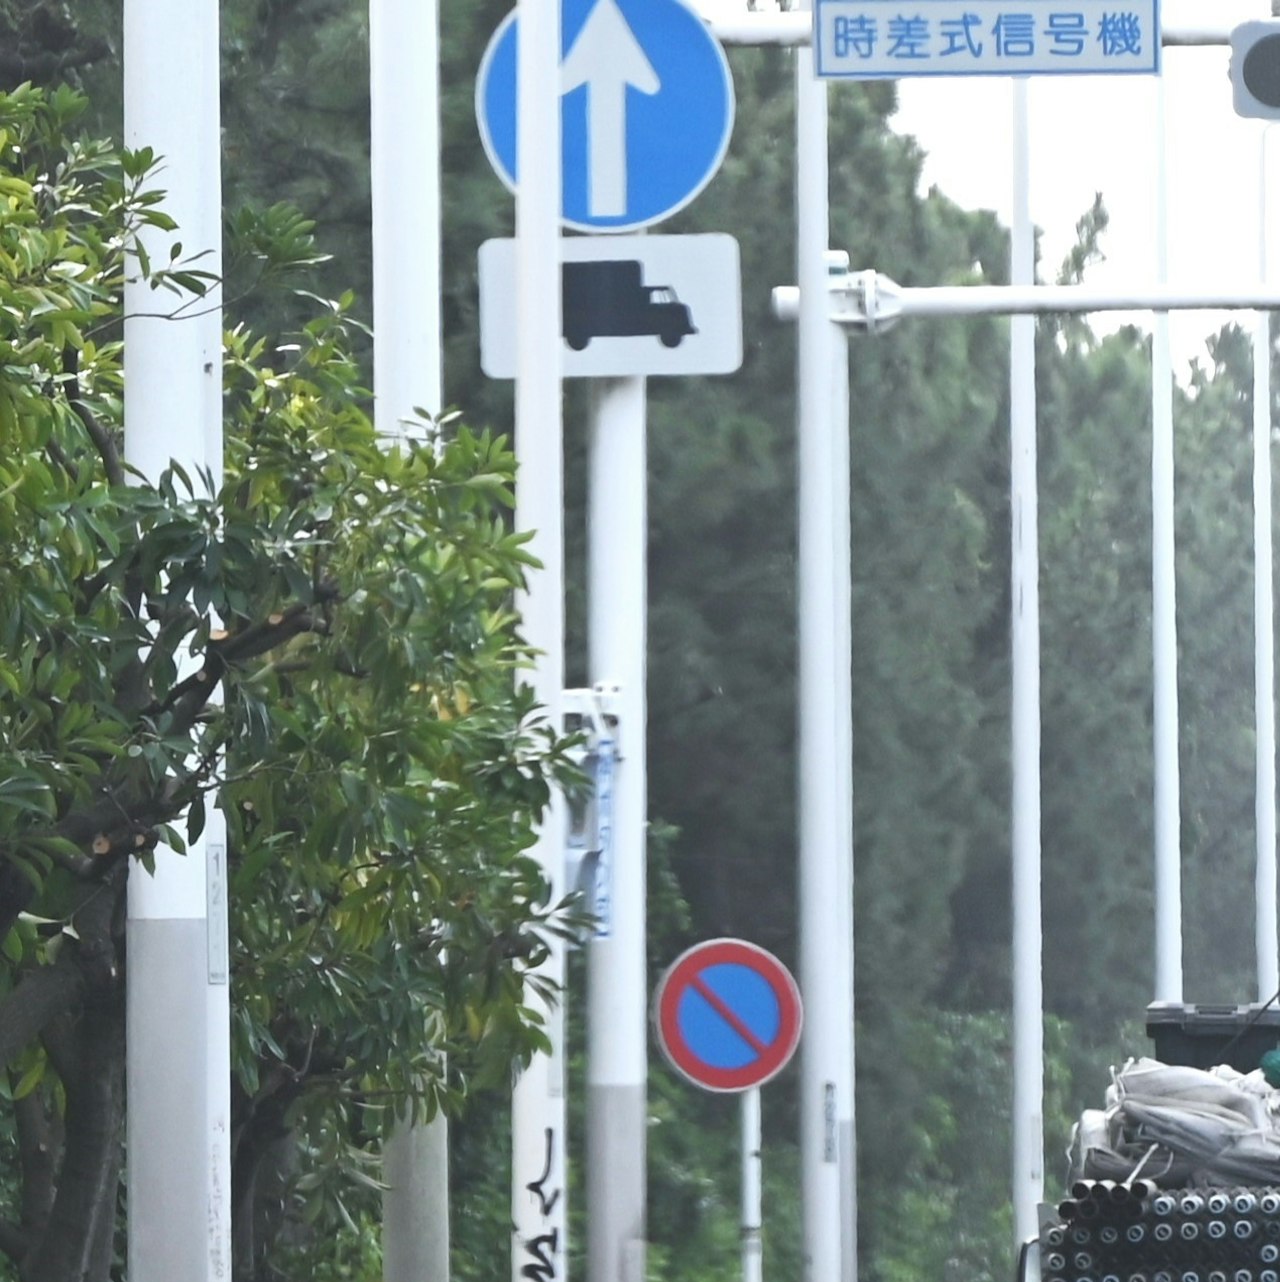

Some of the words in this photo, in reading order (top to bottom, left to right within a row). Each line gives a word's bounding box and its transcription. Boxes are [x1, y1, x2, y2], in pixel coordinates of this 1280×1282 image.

[832, 11, 1142, 59] 時差式信号機
